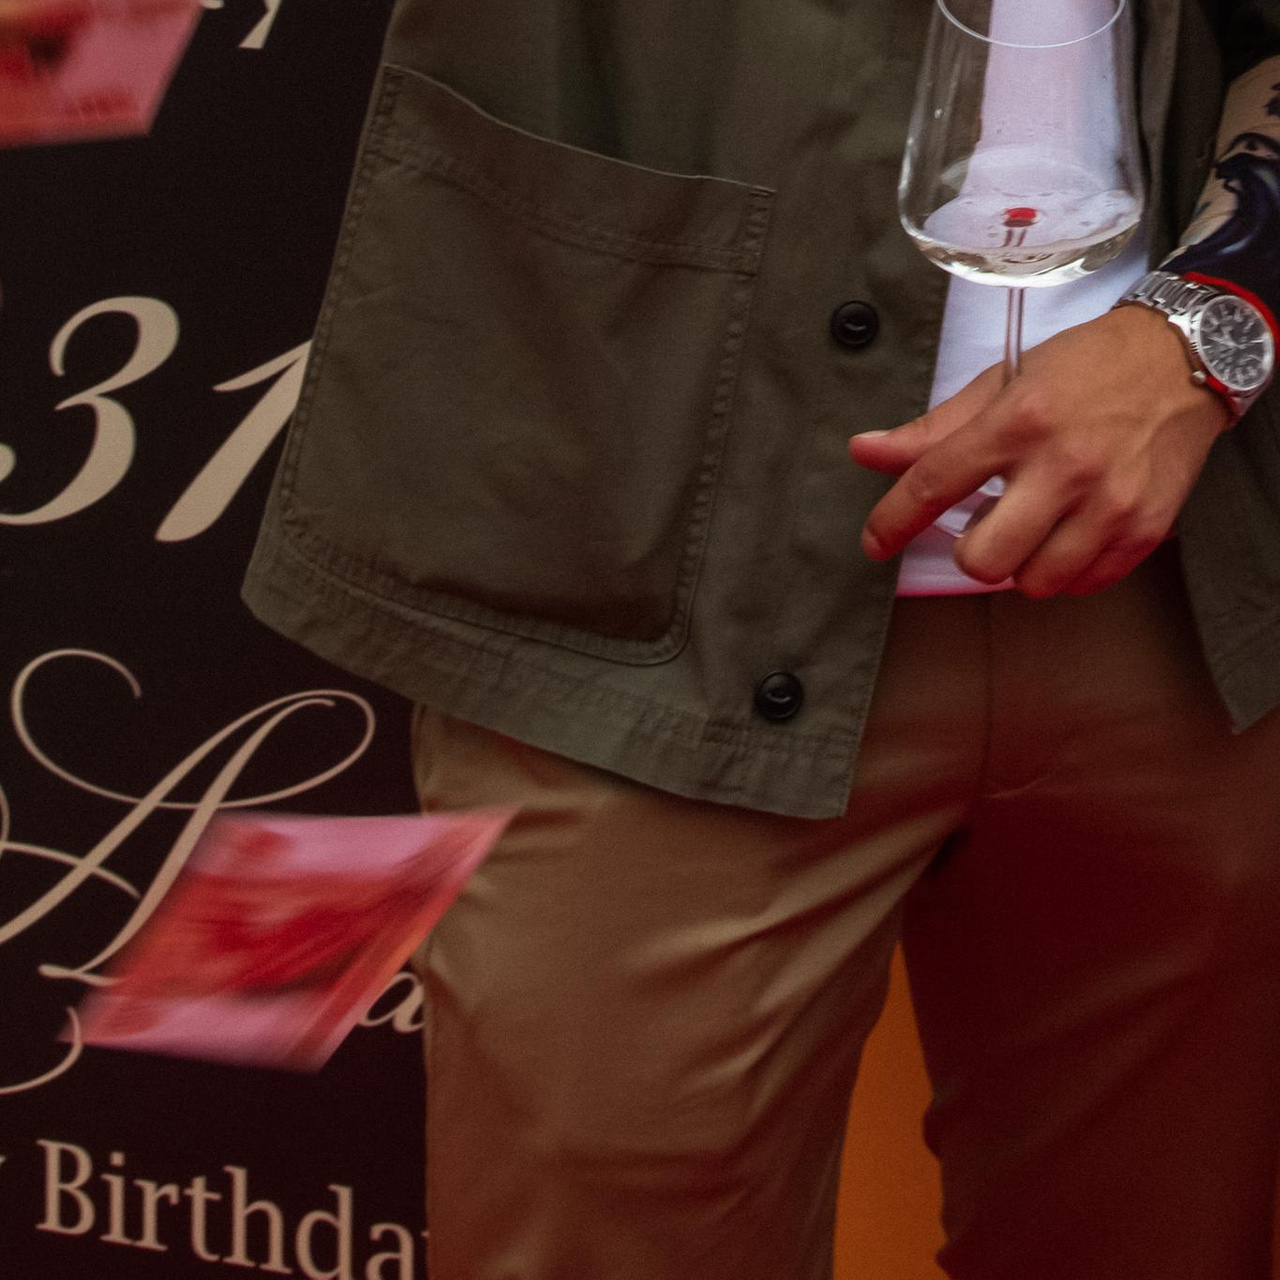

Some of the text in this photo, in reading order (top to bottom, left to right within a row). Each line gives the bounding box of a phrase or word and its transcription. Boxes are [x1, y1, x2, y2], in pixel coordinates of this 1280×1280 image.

[0, 295, 313, 543] 31
[0, 648, 425, 1095] Aa
[37, 1139, 430, 1280] Birthda
